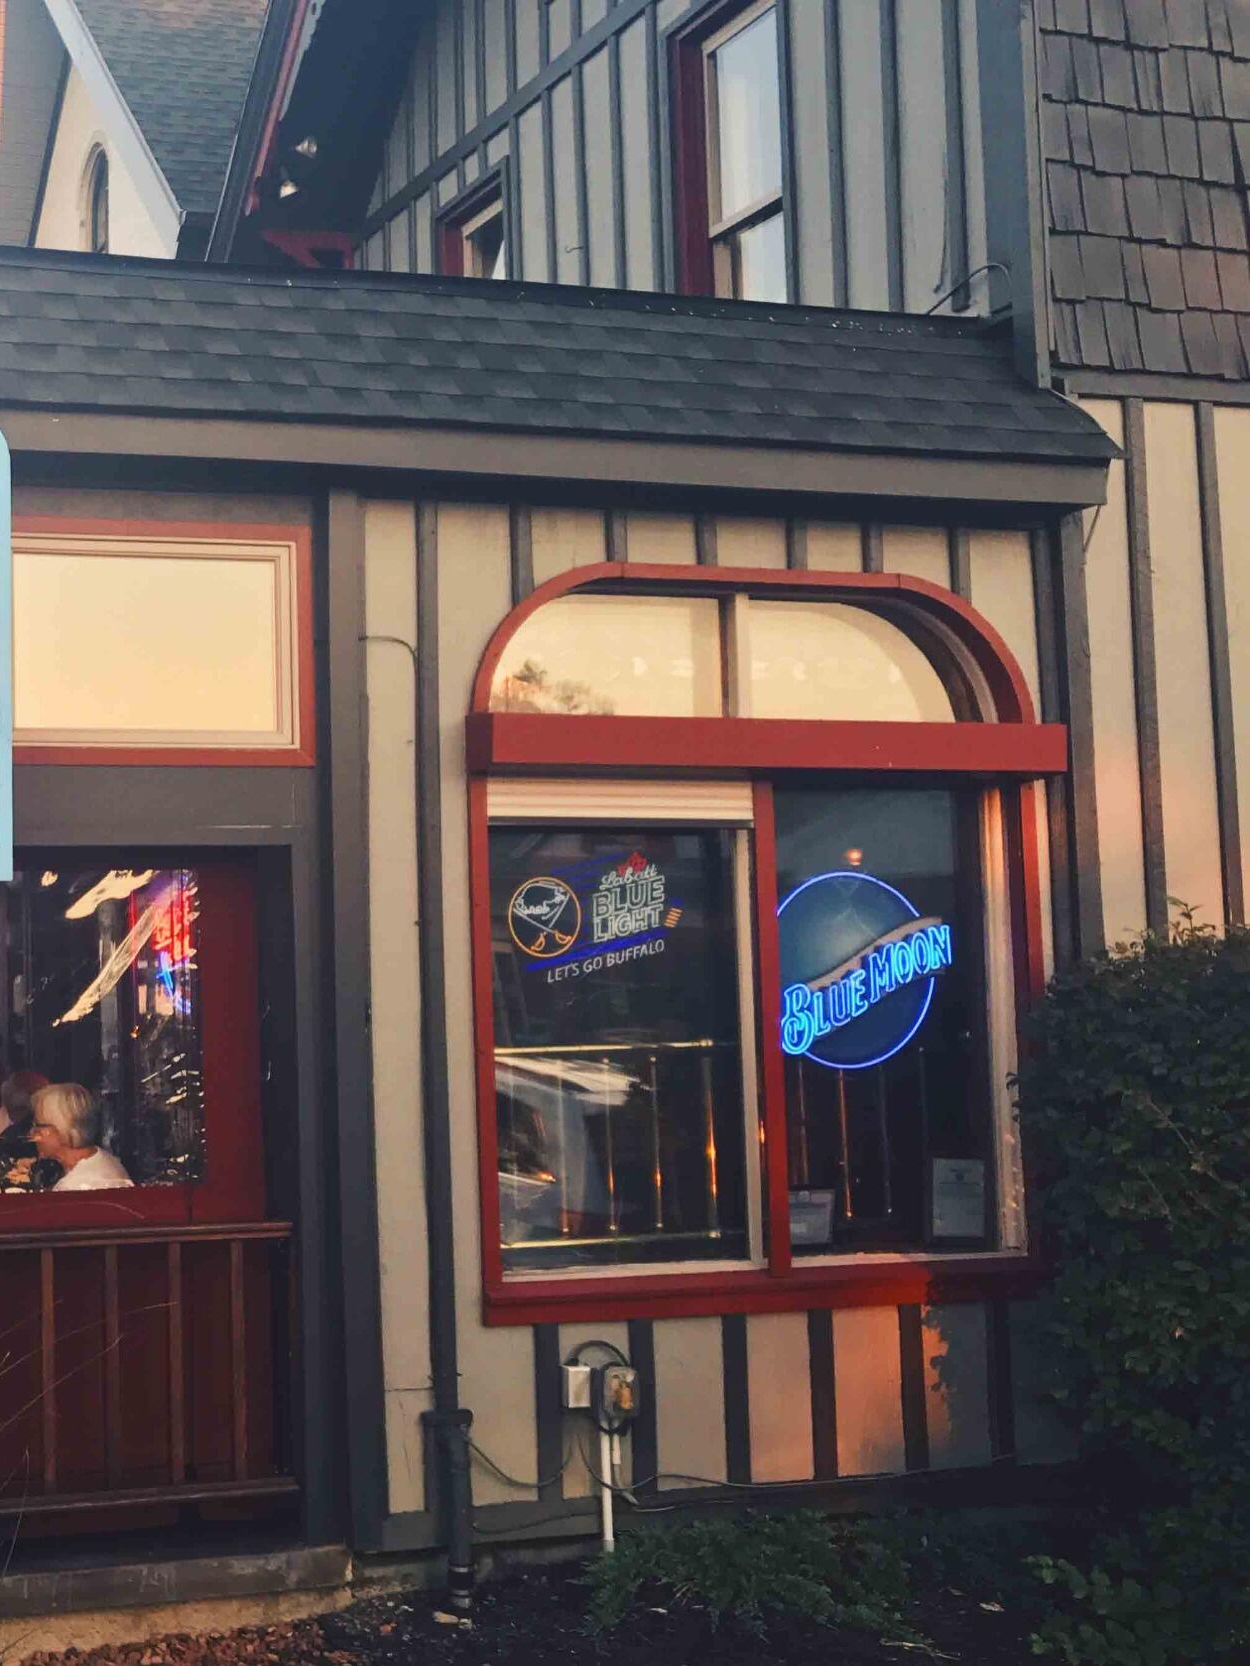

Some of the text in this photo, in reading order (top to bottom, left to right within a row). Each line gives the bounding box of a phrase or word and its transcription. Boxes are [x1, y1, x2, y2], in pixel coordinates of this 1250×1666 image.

[592, 875, 666, 918] BLUE
[599, 863, 658, 891] Labatt
[592, 903, 664, 943] LIGHT
[546, 939, 665, 984] LET'S GO BUFFALO
[781, 925, 952, 1055] BLUE MOON
